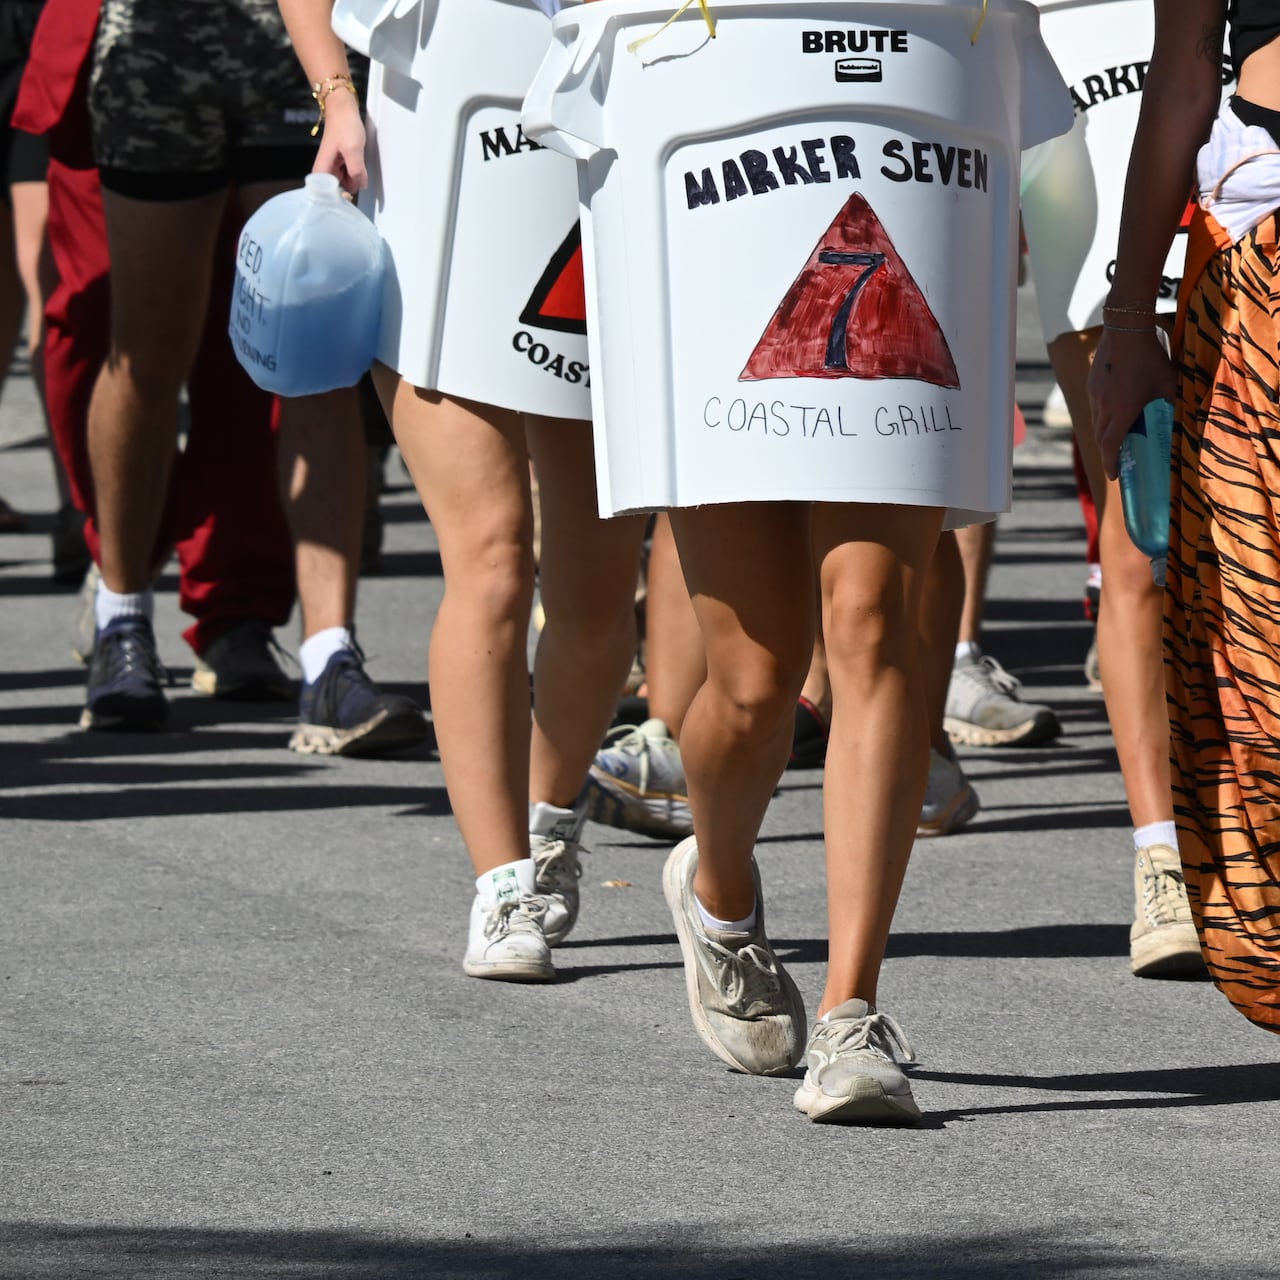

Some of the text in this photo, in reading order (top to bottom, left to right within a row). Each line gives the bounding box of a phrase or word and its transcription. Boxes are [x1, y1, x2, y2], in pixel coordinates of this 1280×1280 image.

[801, 30, 908, 53] BRUTE
[684, 135, 989, 210] MARKER SEVEN
[818, 250, 887, 370] 7
[703, 396, 963, 438] COASTAL GRILL
